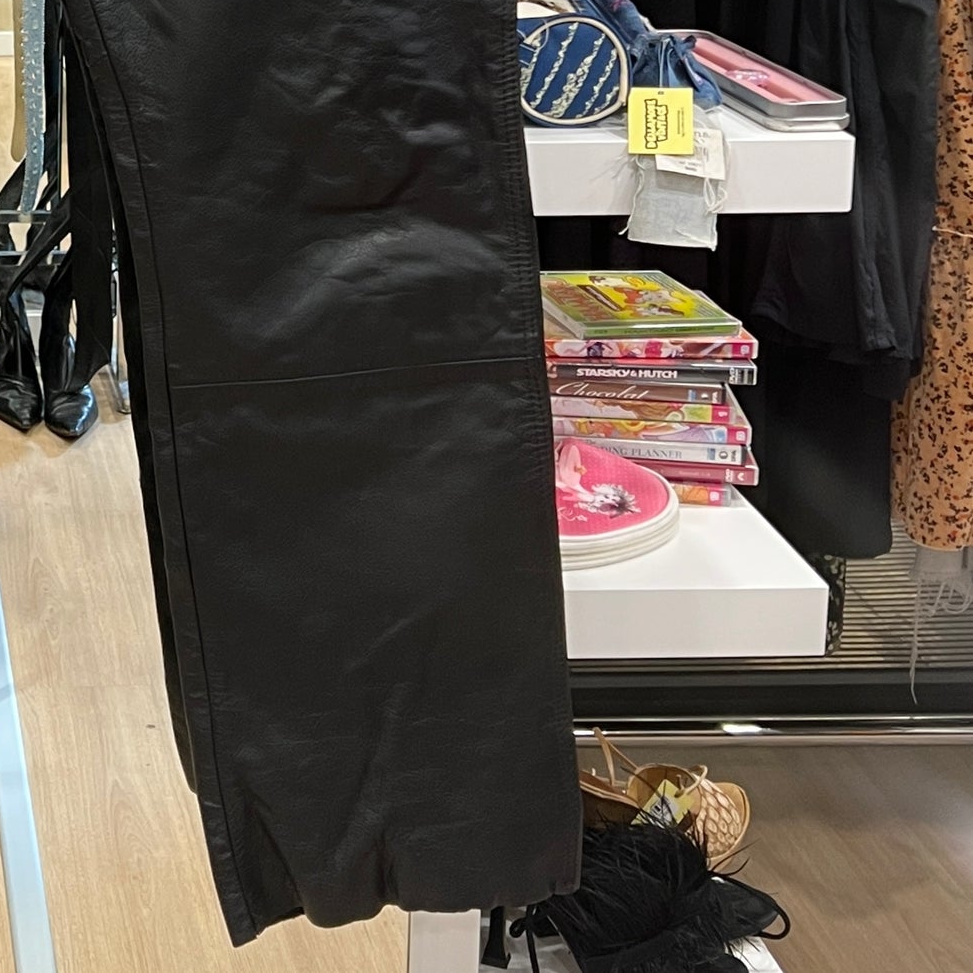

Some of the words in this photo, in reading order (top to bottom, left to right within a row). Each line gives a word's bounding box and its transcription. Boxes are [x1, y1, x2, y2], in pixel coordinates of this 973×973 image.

[577, 368, 631, 378] STARSKY
[637, 370, 678, 379] HUTCH
[555, 381, 649, 399] Chocolat
[631, 448, 682, 459] PLANNER
